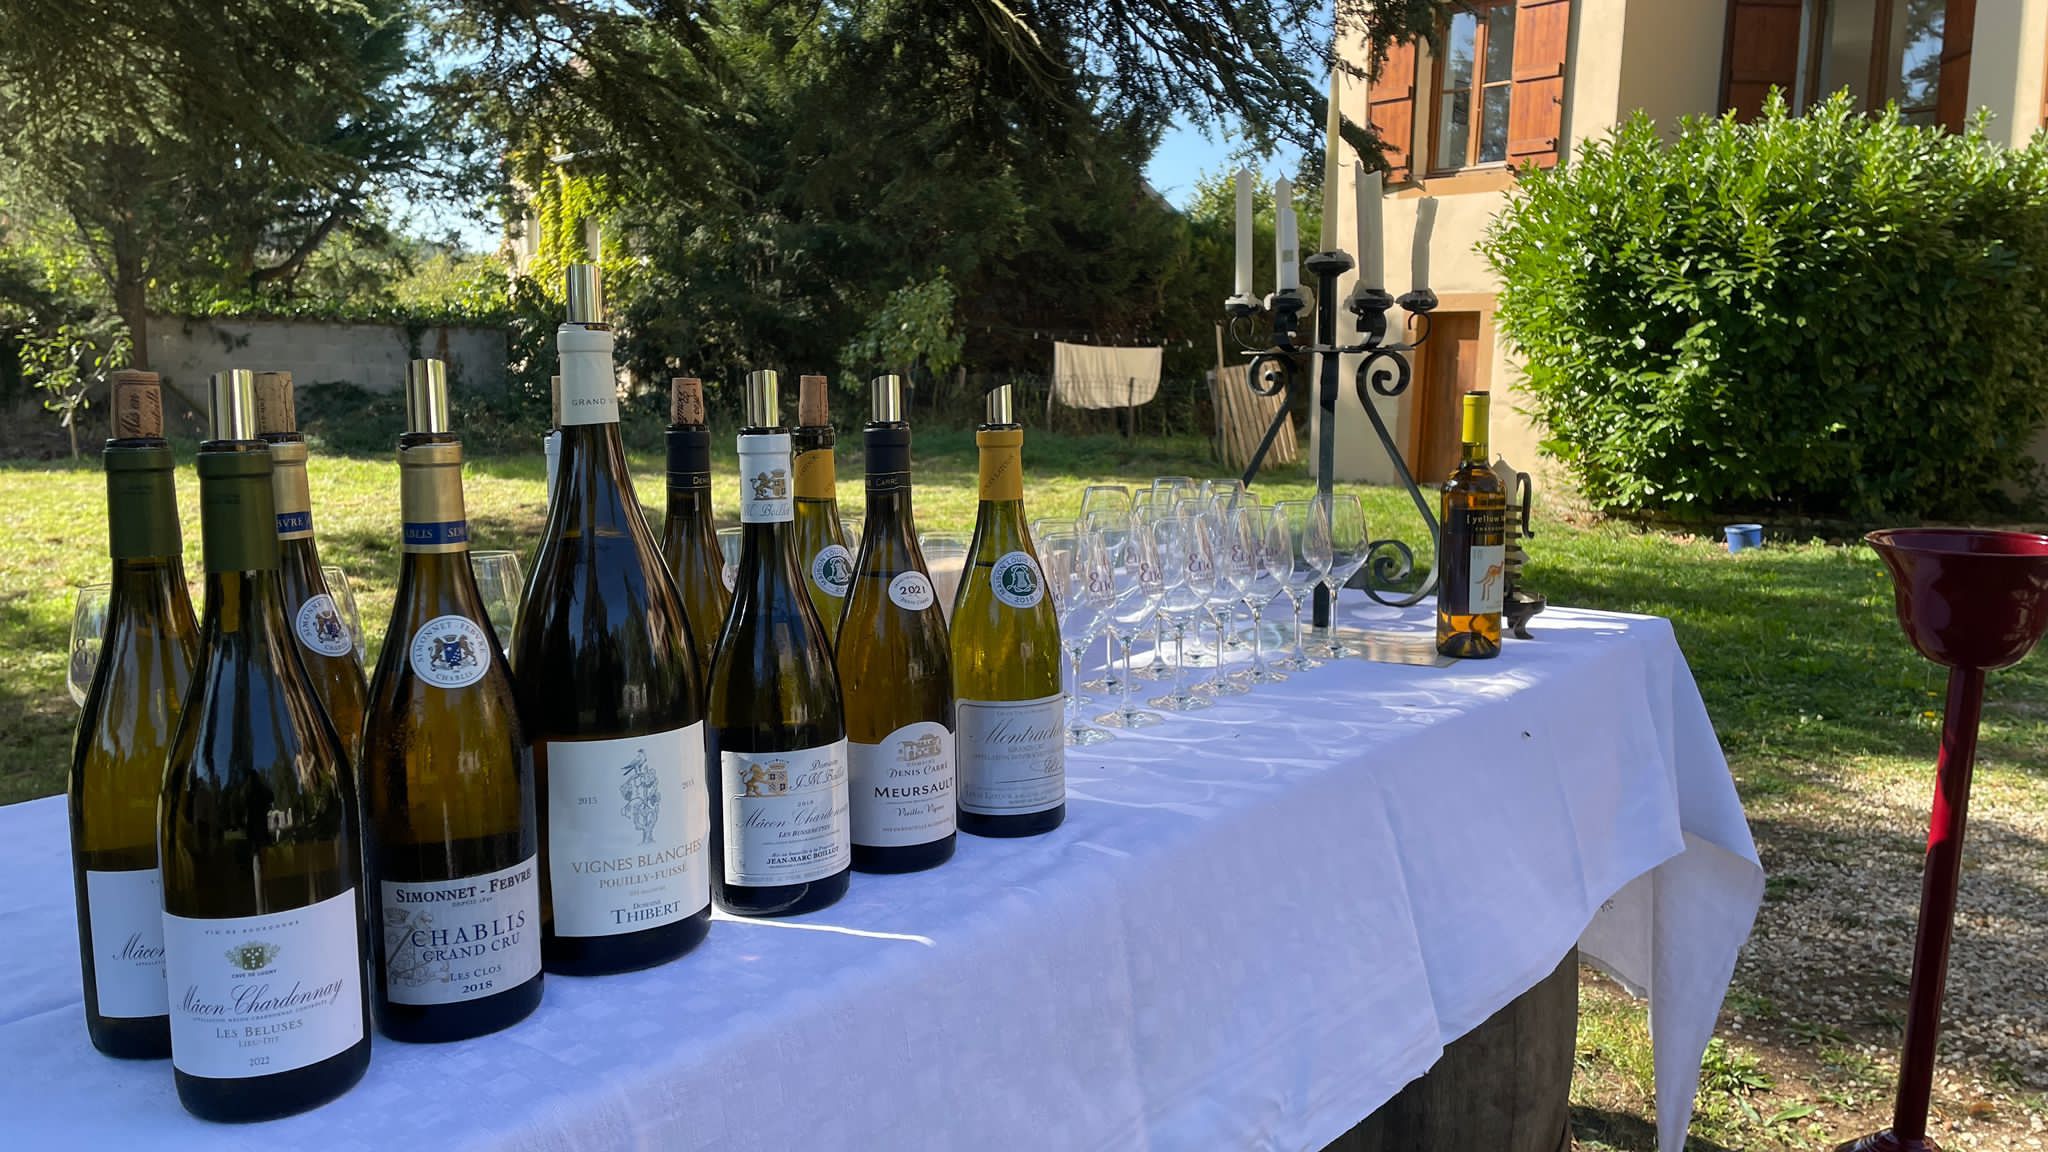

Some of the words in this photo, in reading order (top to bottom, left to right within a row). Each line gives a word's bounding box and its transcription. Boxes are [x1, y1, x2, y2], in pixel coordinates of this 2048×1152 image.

[571, 398, 606, 406] GRAND
[899, 584, 926, 595] 2021
[873, 776, 954, 799] MEURSAULT
[572, 856, 634, 874] VIGNES
[637, 838, 703, 868] BLANCHES
[765, 853, 812, 865] JEAN-MARC
[394, 885, 478, 904] SIMONNET
[488, 866, 532, 894] FEBVRE
[610, 899, 681, 925] THIBERT
[410, 909, 526, 948] CHABLIS
[422, 943, 486, 962] GRAND
[490, 931, 521, 952] CRU
[449, 971, 471, 983] LES
[472, 965, 502, 978] CLOS
[461, 979, 493, 994] 2018
[216, 1027, 238, 1039] LES
[244, 1018, 304, 1038] BELUSES
[249, 1056, 271, 1067] 2022
